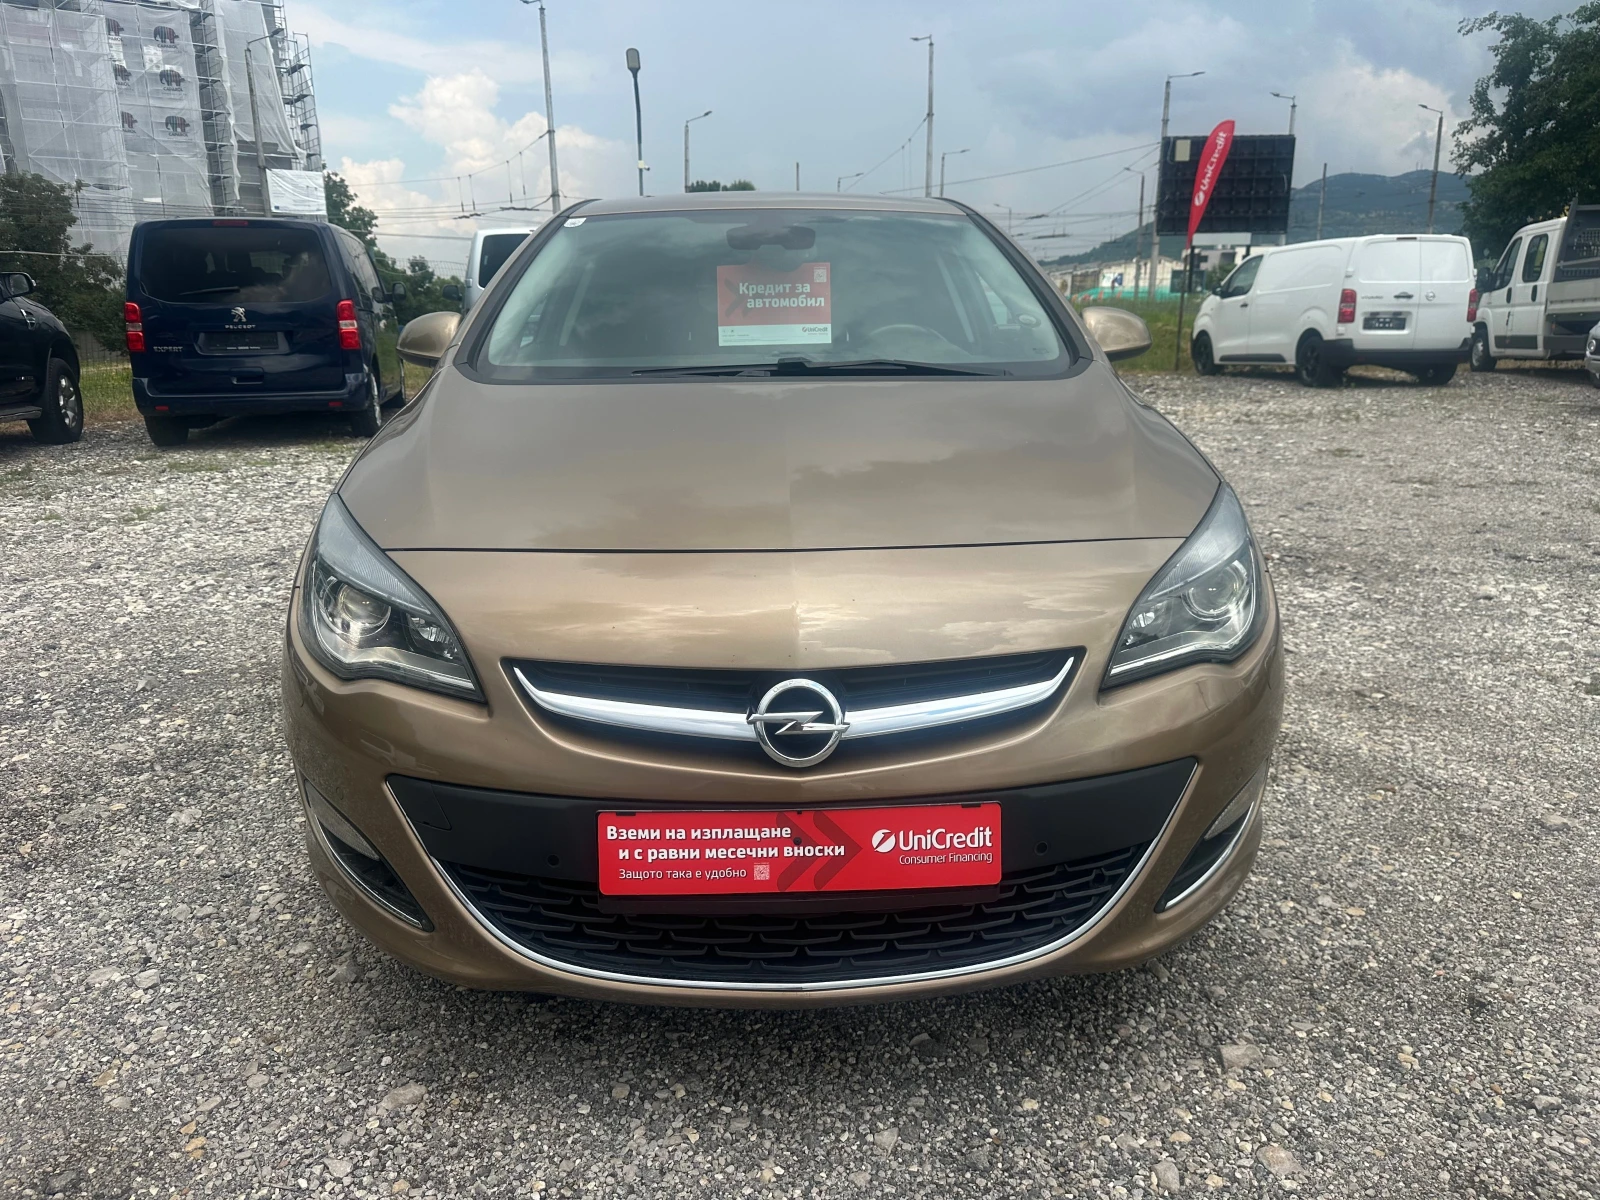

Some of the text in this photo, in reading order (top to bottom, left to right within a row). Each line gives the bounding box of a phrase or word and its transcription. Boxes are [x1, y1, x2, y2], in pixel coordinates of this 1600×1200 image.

[1200, 131, 1228, 190] UniCredit
[739, 282, 811, 296] Кредит за
[747, 295, 825, 308] автомобил
[606, 825, 791, 842] Вземи на изплащане
[899, 826, 992, 849] UniCredit
[619, 844, 845, 863] и с равни месечни вноски
[899, 851, 992, 865] Consumer Financing
[618, 866, 747, 881] Защото така е удобно
